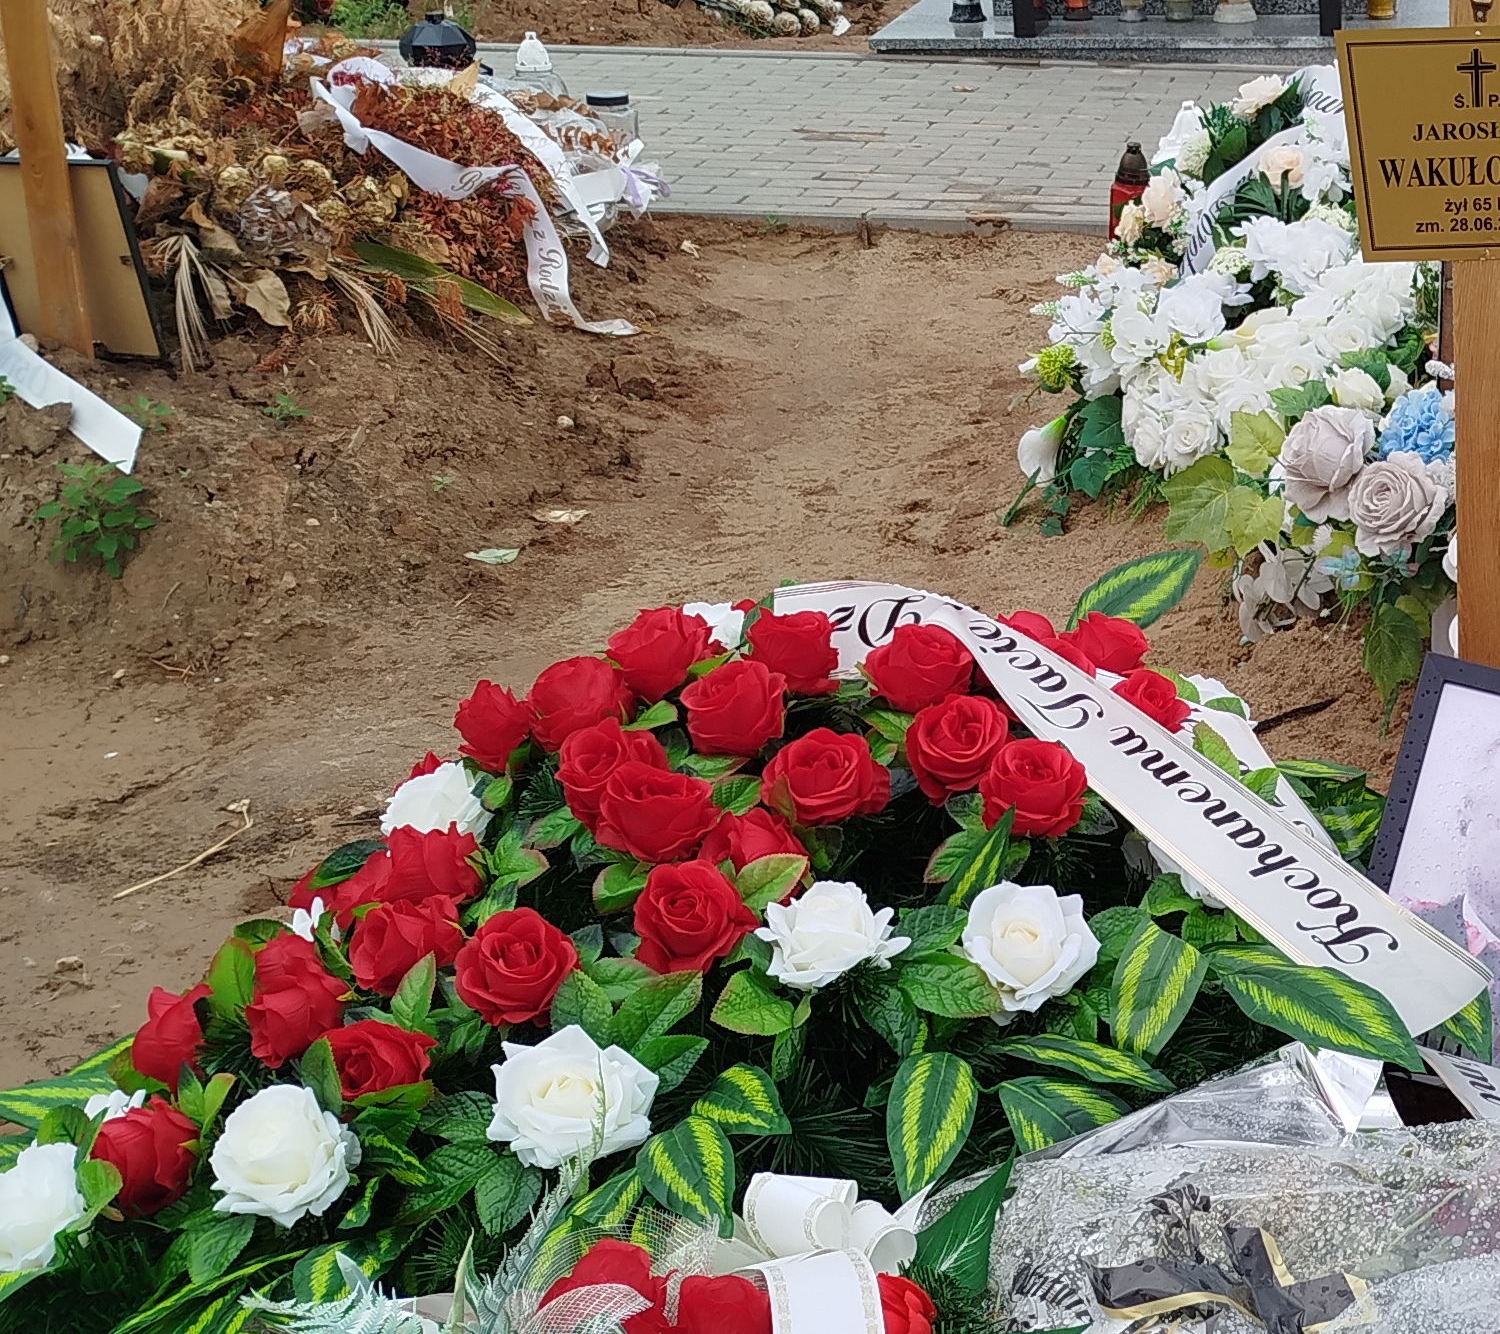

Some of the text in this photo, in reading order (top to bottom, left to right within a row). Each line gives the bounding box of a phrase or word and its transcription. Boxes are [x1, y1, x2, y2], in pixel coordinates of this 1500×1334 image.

[1444, 198, 1468, 213] żył
[1472, 198, 1493, 212] 65
[1415, 221, 1446, 234] zm.
[1109, 725, 1400, 967] Kochanemu
